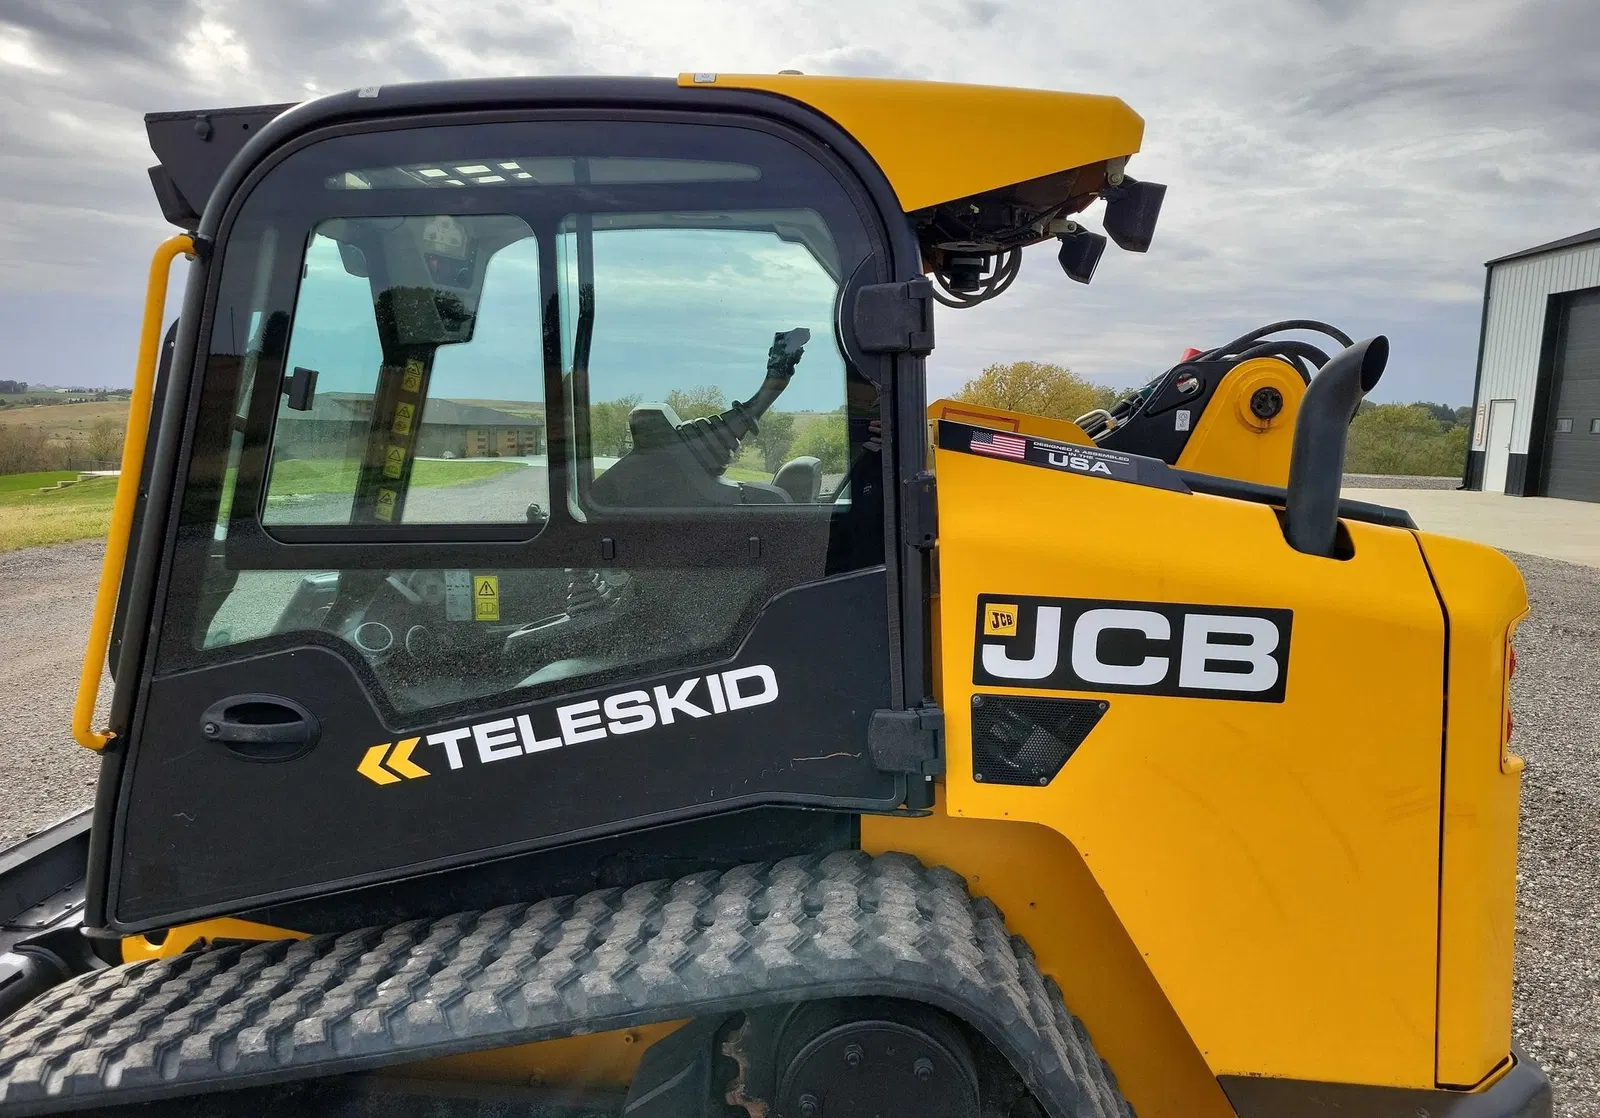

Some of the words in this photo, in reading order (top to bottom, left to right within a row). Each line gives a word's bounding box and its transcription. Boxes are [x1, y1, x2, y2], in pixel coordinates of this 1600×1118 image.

[1033, 441, 1072, 452] DESIGNED
[1082, 450, 1130, 462] ASSEMBLED
[1048, 452, 1112, 475] USA
[992, 611, 1013, 629] JCB
[982, 605, 1280, 692] JCB
[426, 664, 779, 770] TELESKID
